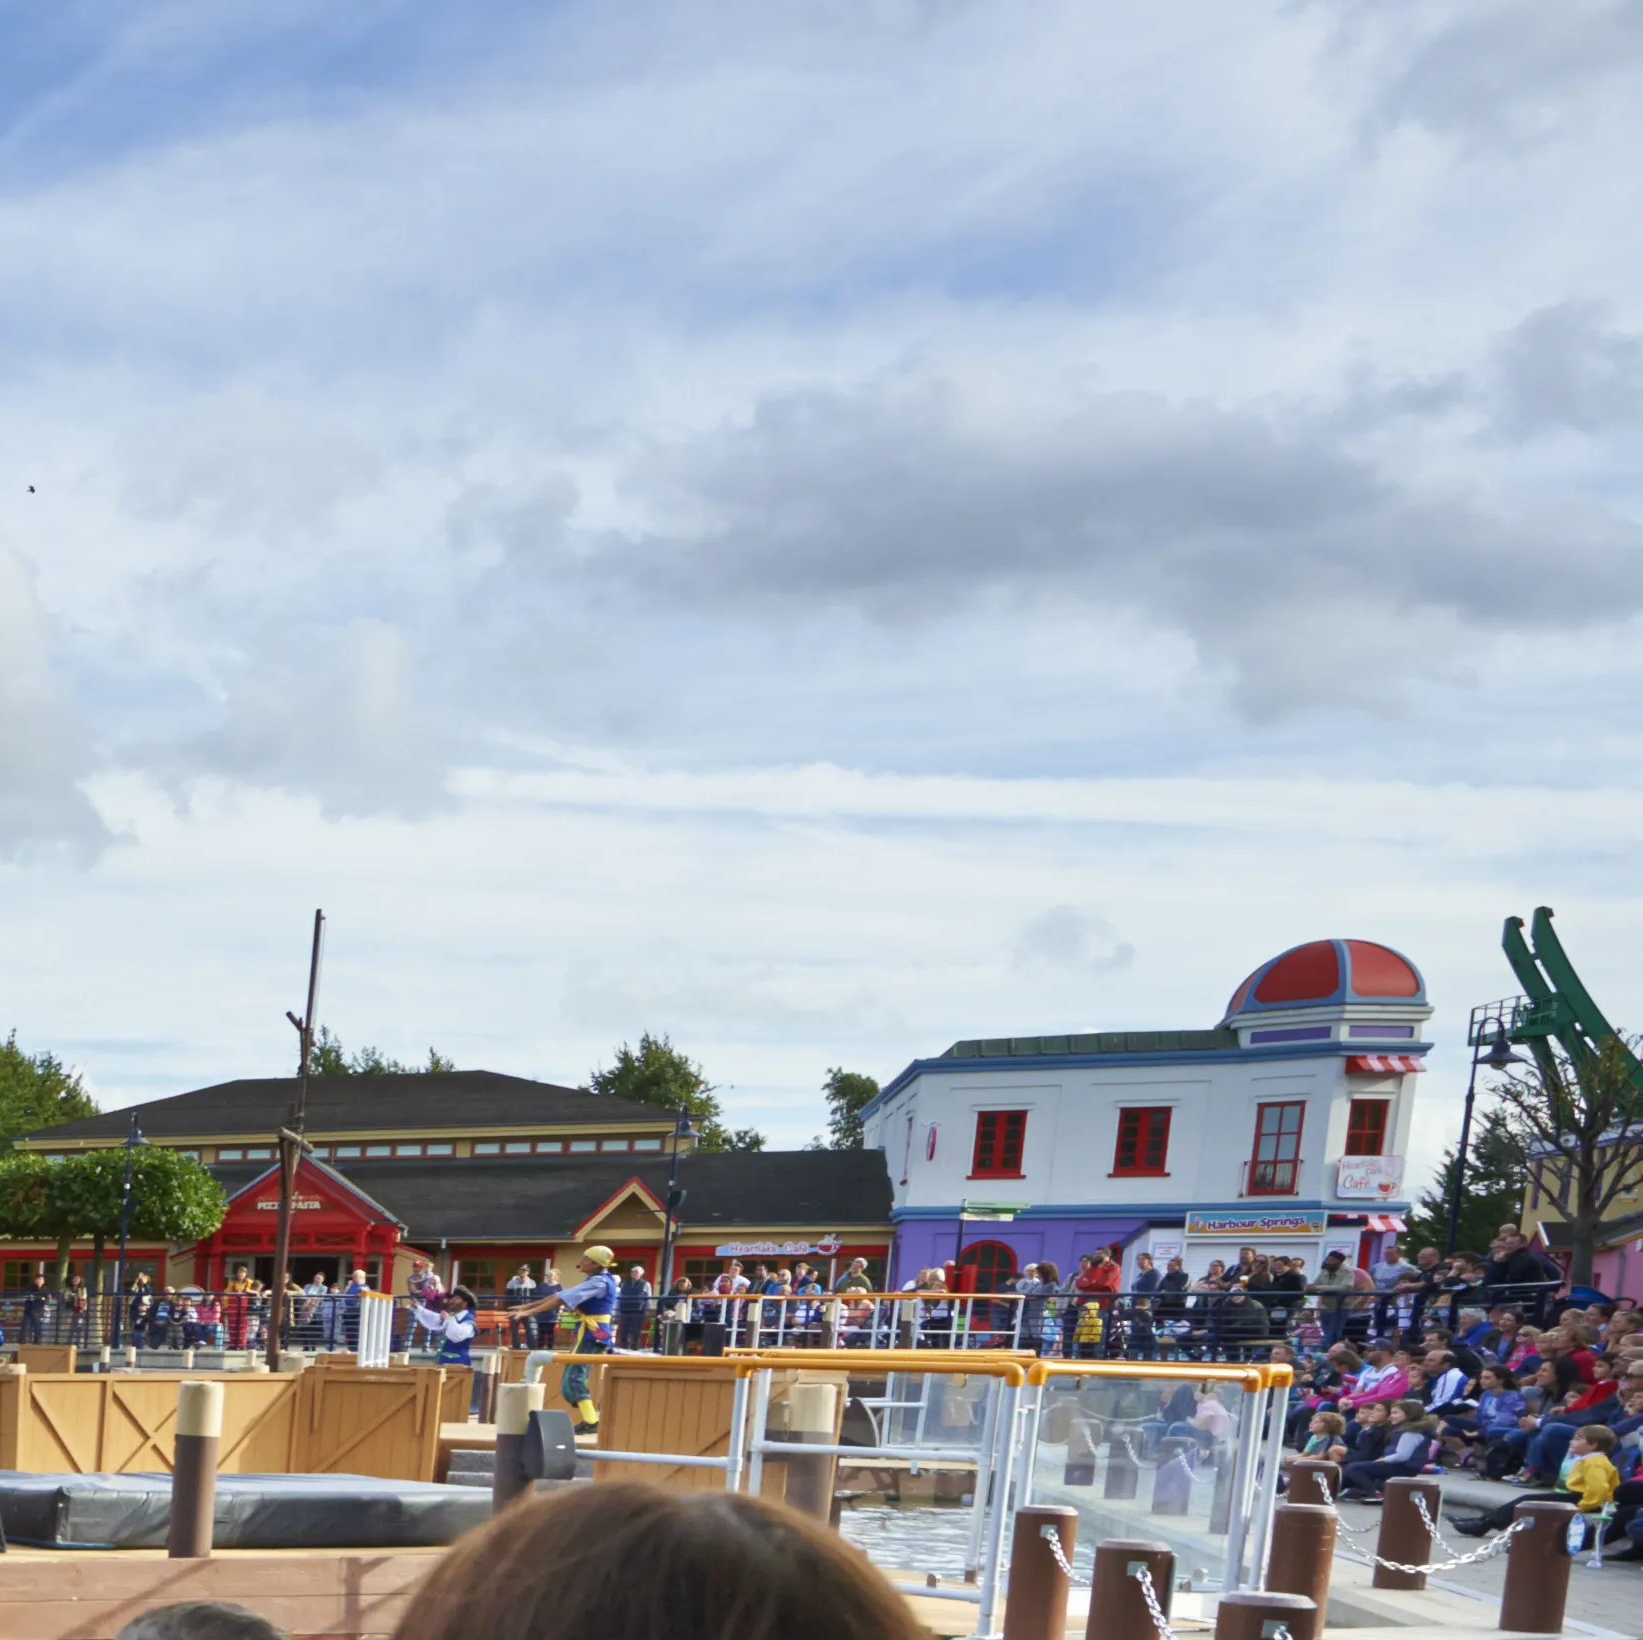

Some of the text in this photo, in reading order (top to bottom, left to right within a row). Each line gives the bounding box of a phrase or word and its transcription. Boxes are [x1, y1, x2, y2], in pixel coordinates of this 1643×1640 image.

[292, 1201, 321, 1209] PASTA
[1208, 1217, 1305, 1230] Harbour Springs
